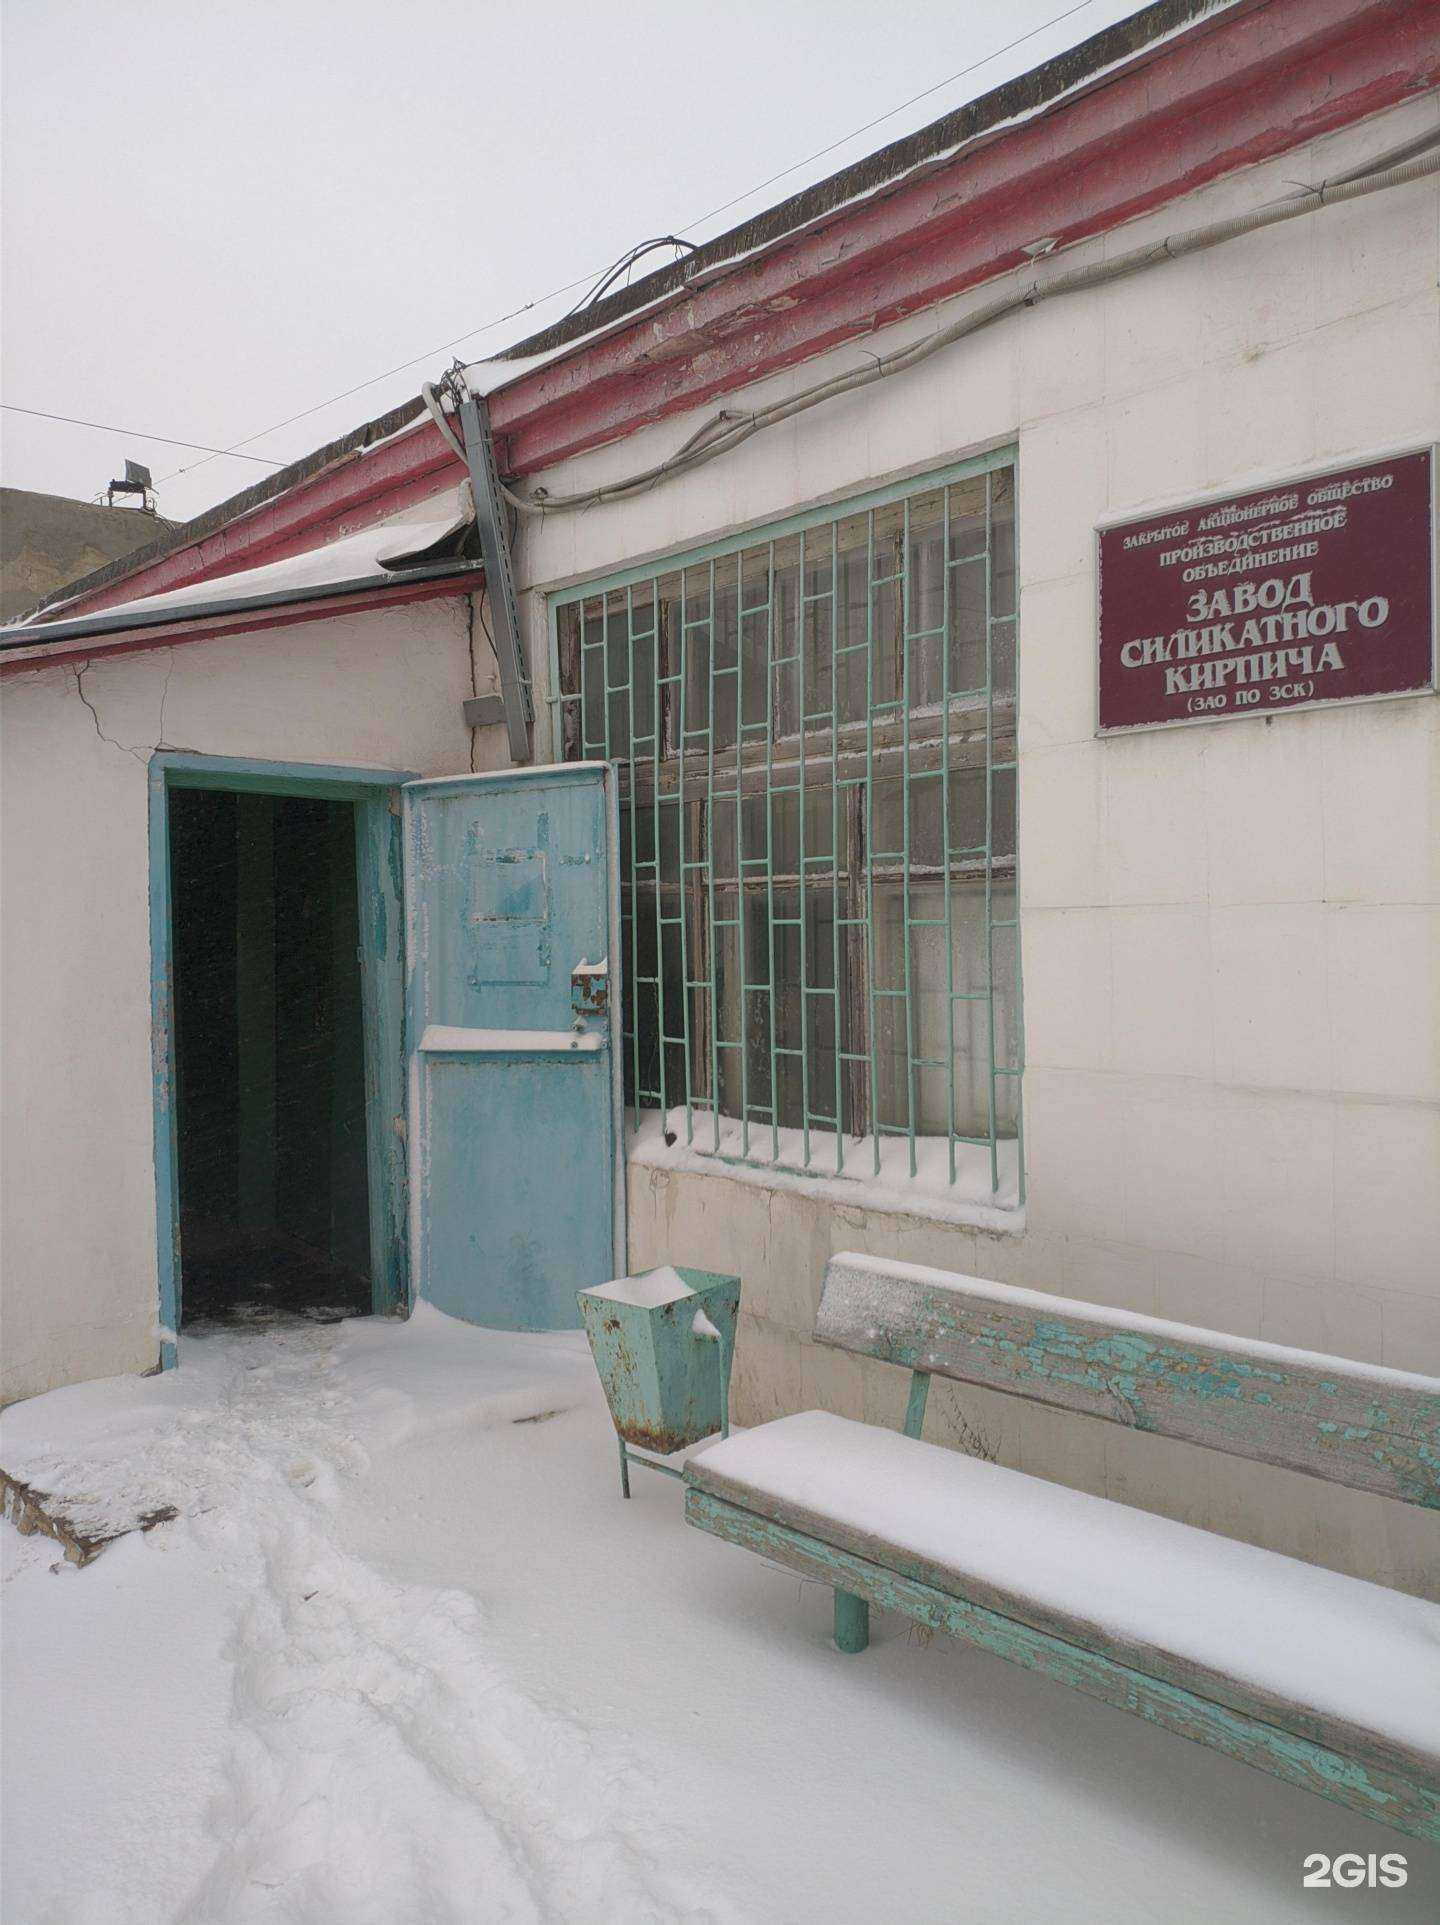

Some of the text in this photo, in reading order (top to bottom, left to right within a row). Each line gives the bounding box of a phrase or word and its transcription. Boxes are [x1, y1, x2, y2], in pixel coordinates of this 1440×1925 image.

[1123, 474, 1394, 550] ЗАКРЫТОЕ АКЦИОНЕРНОЕ ОБЩЕСТВО
[1160, 511, 1347, 567] ПРОИЗВОДСТВЕННОЕ
[1182, 541, 1319, 583] ОБЪЕДИНЕНИЕ
[1187, 570, 1314, 622] ЗАВОД
[1120, 595, 1389, 668] СИЛИКАТНОГО
[1165, 642, 1345, 695] КИРПИЧА
[1187, 679, 1314, 712] (ЗАО ПО ЗСК)
